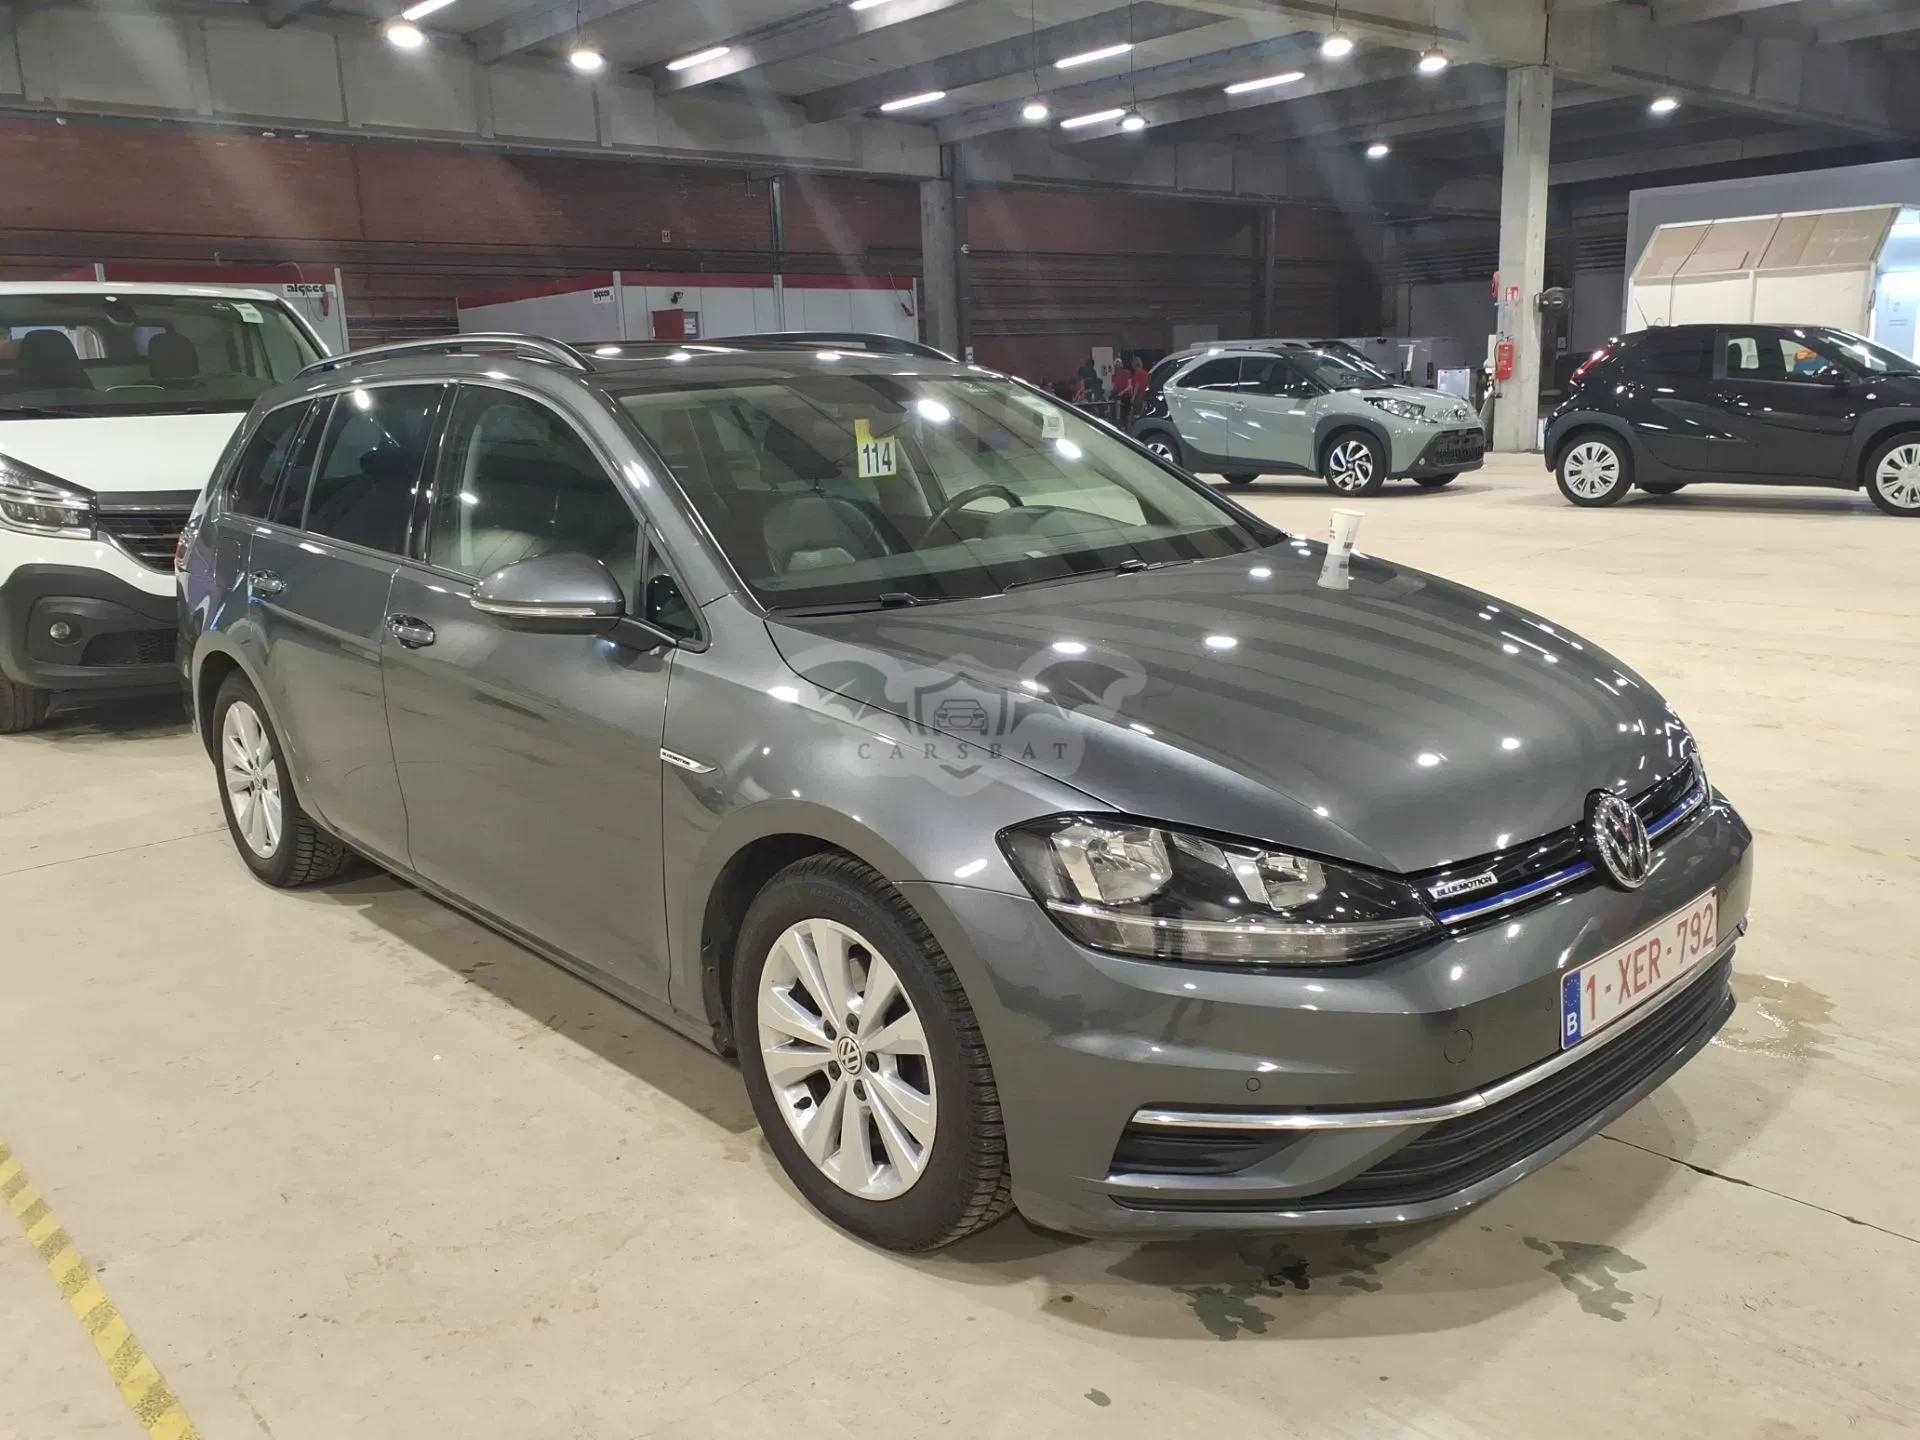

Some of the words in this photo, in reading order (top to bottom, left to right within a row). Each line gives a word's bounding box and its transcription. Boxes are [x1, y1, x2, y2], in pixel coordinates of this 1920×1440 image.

[863, 442, 892, 474] 114
[1436, 875, 1492, 897] BLUEMOTION
[1586, 902, 1715, 1021] 1-XER-792
[1566, 1011, 1578, 1037] B
